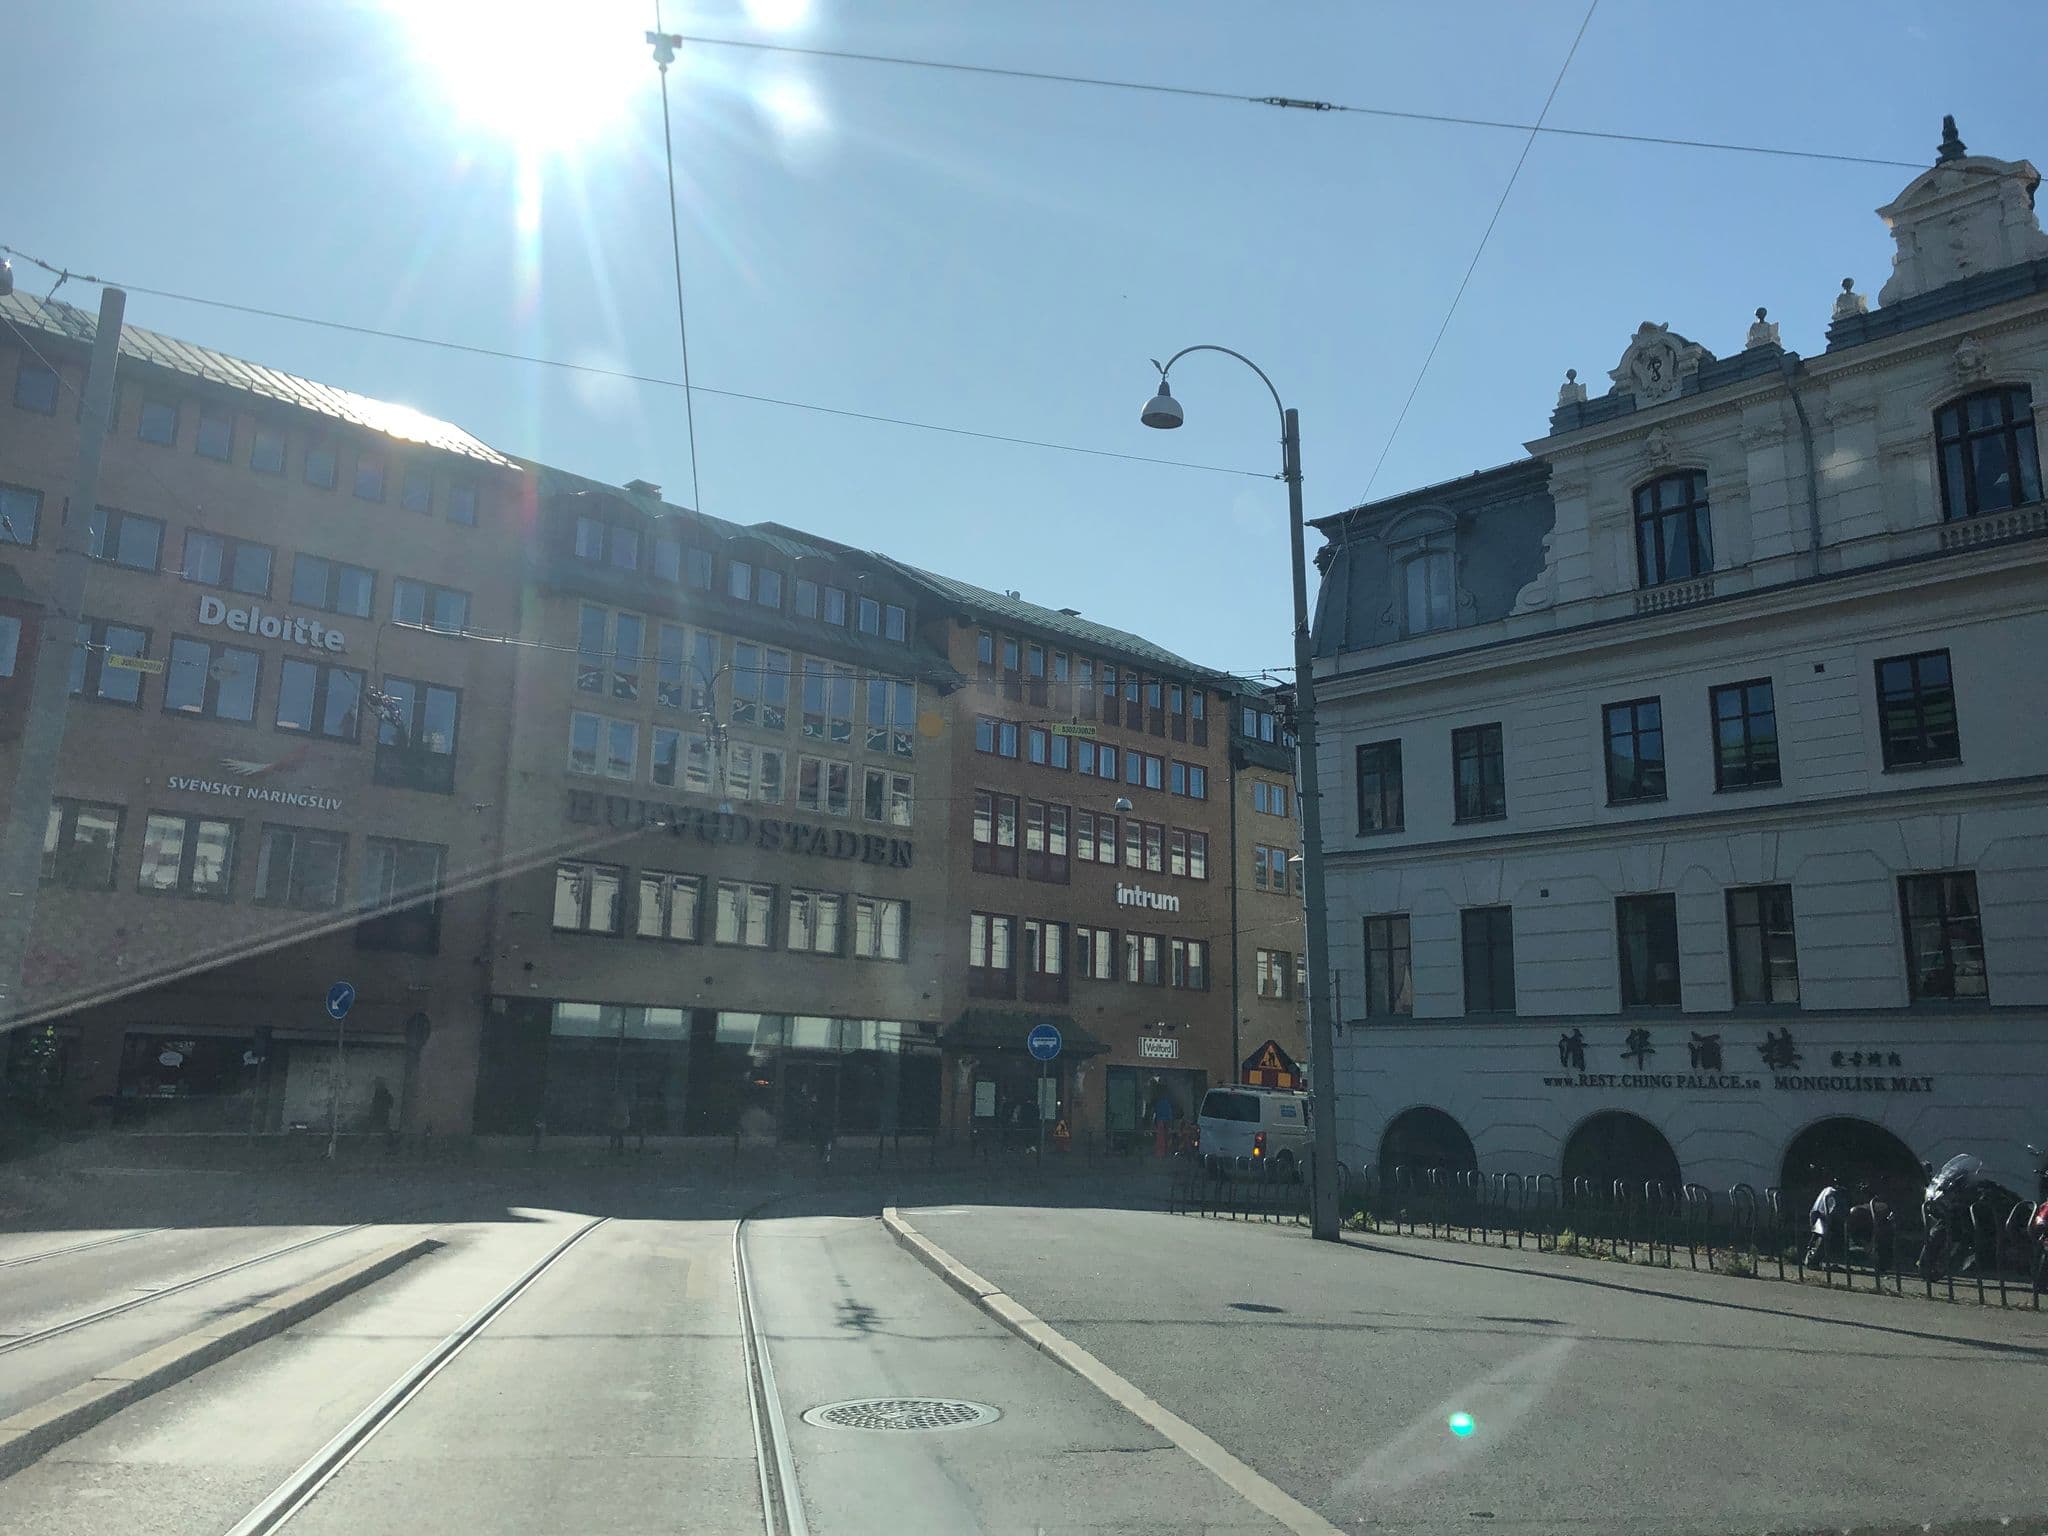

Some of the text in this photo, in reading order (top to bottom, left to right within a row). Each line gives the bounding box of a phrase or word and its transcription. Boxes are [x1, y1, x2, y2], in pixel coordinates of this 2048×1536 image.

[168, 776, 243, 798] SVENSKT
[1117, 882, 1180, 912] intrum
[1774, 1076, 1887, 1091] MONGOLISK
[1891, 1077, 1935, 1092] MAT
